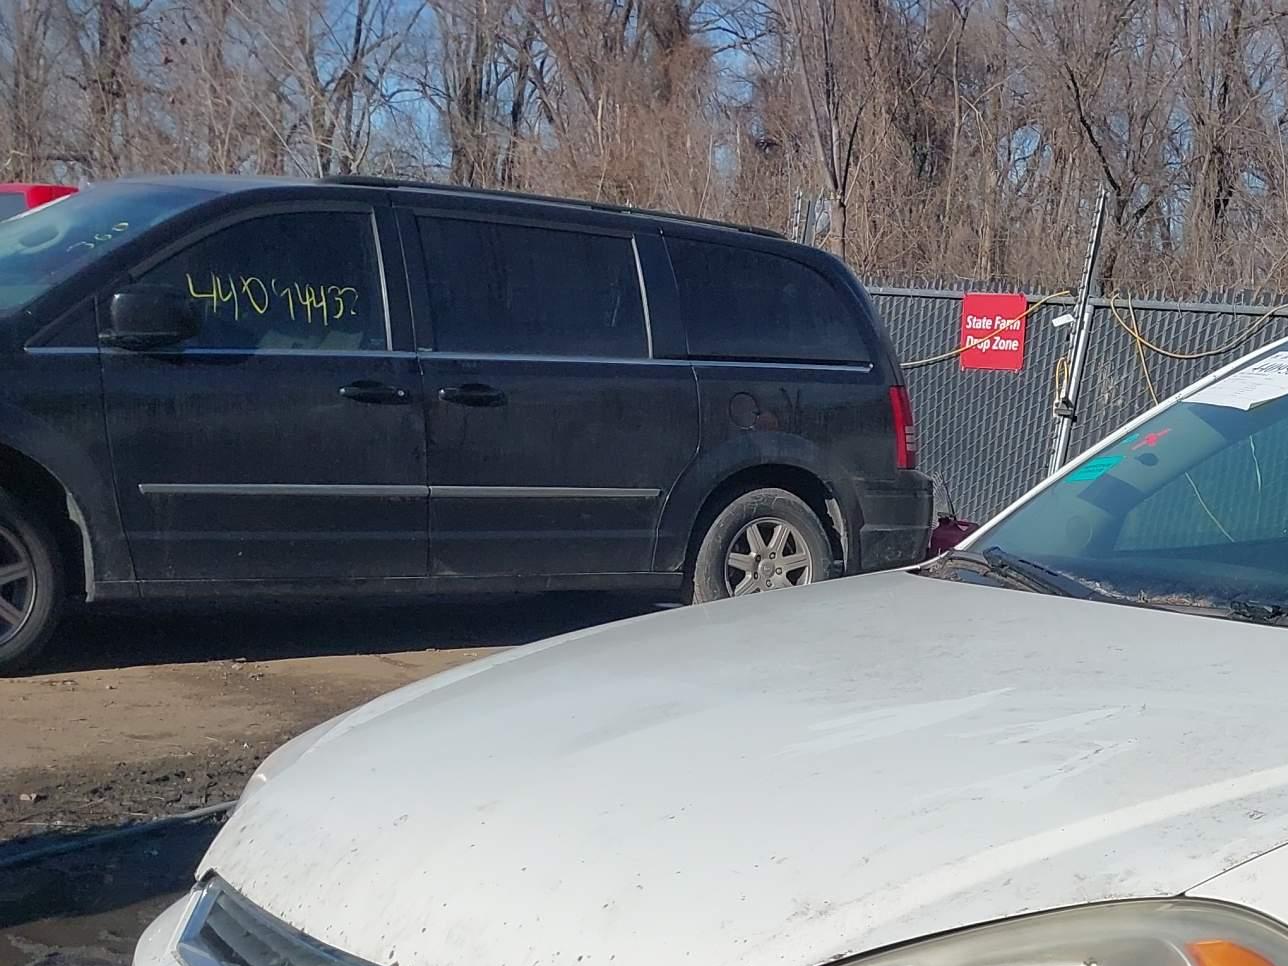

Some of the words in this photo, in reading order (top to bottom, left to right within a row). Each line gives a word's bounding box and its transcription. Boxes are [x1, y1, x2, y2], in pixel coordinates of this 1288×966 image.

[965, 315, 993, 330] State
[994, 316, 1021, 331] Farm
[991, 336, 1019, 351] Zone
